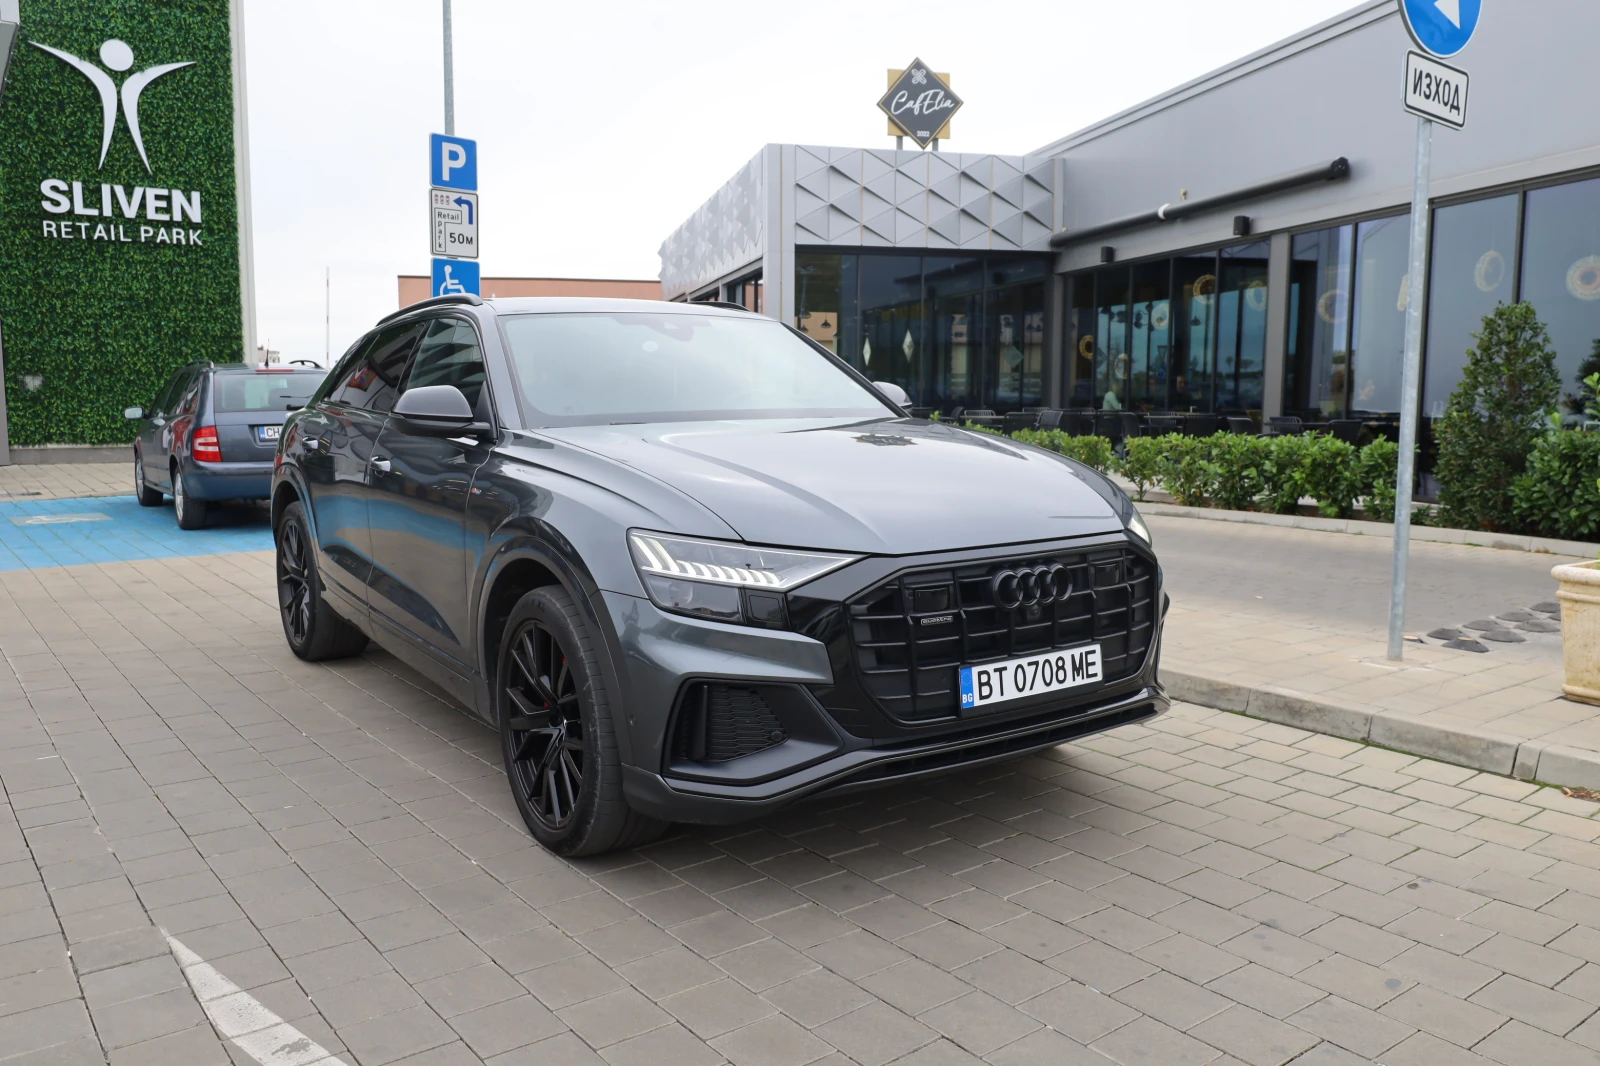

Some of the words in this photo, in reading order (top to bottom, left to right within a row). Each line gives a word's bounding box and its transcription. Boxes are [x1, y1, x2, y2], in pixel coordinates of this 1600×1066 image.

[1413, 67, 1460, 116] ИЗХОД
[442, 141, 466, 181] P
[40, 178, 202, 223] SLIVEN
[437, 211, 460, 220] Retail
[42, 220, 132, 242] RETAIL
[140, 226, 203, 246] PARK
[977, 667, 1007, 700] BT
[1014, 656, 1067, 693] 0708
[1071, 650, 1098, 681] ME
[962, 692, 973, 703] BG
